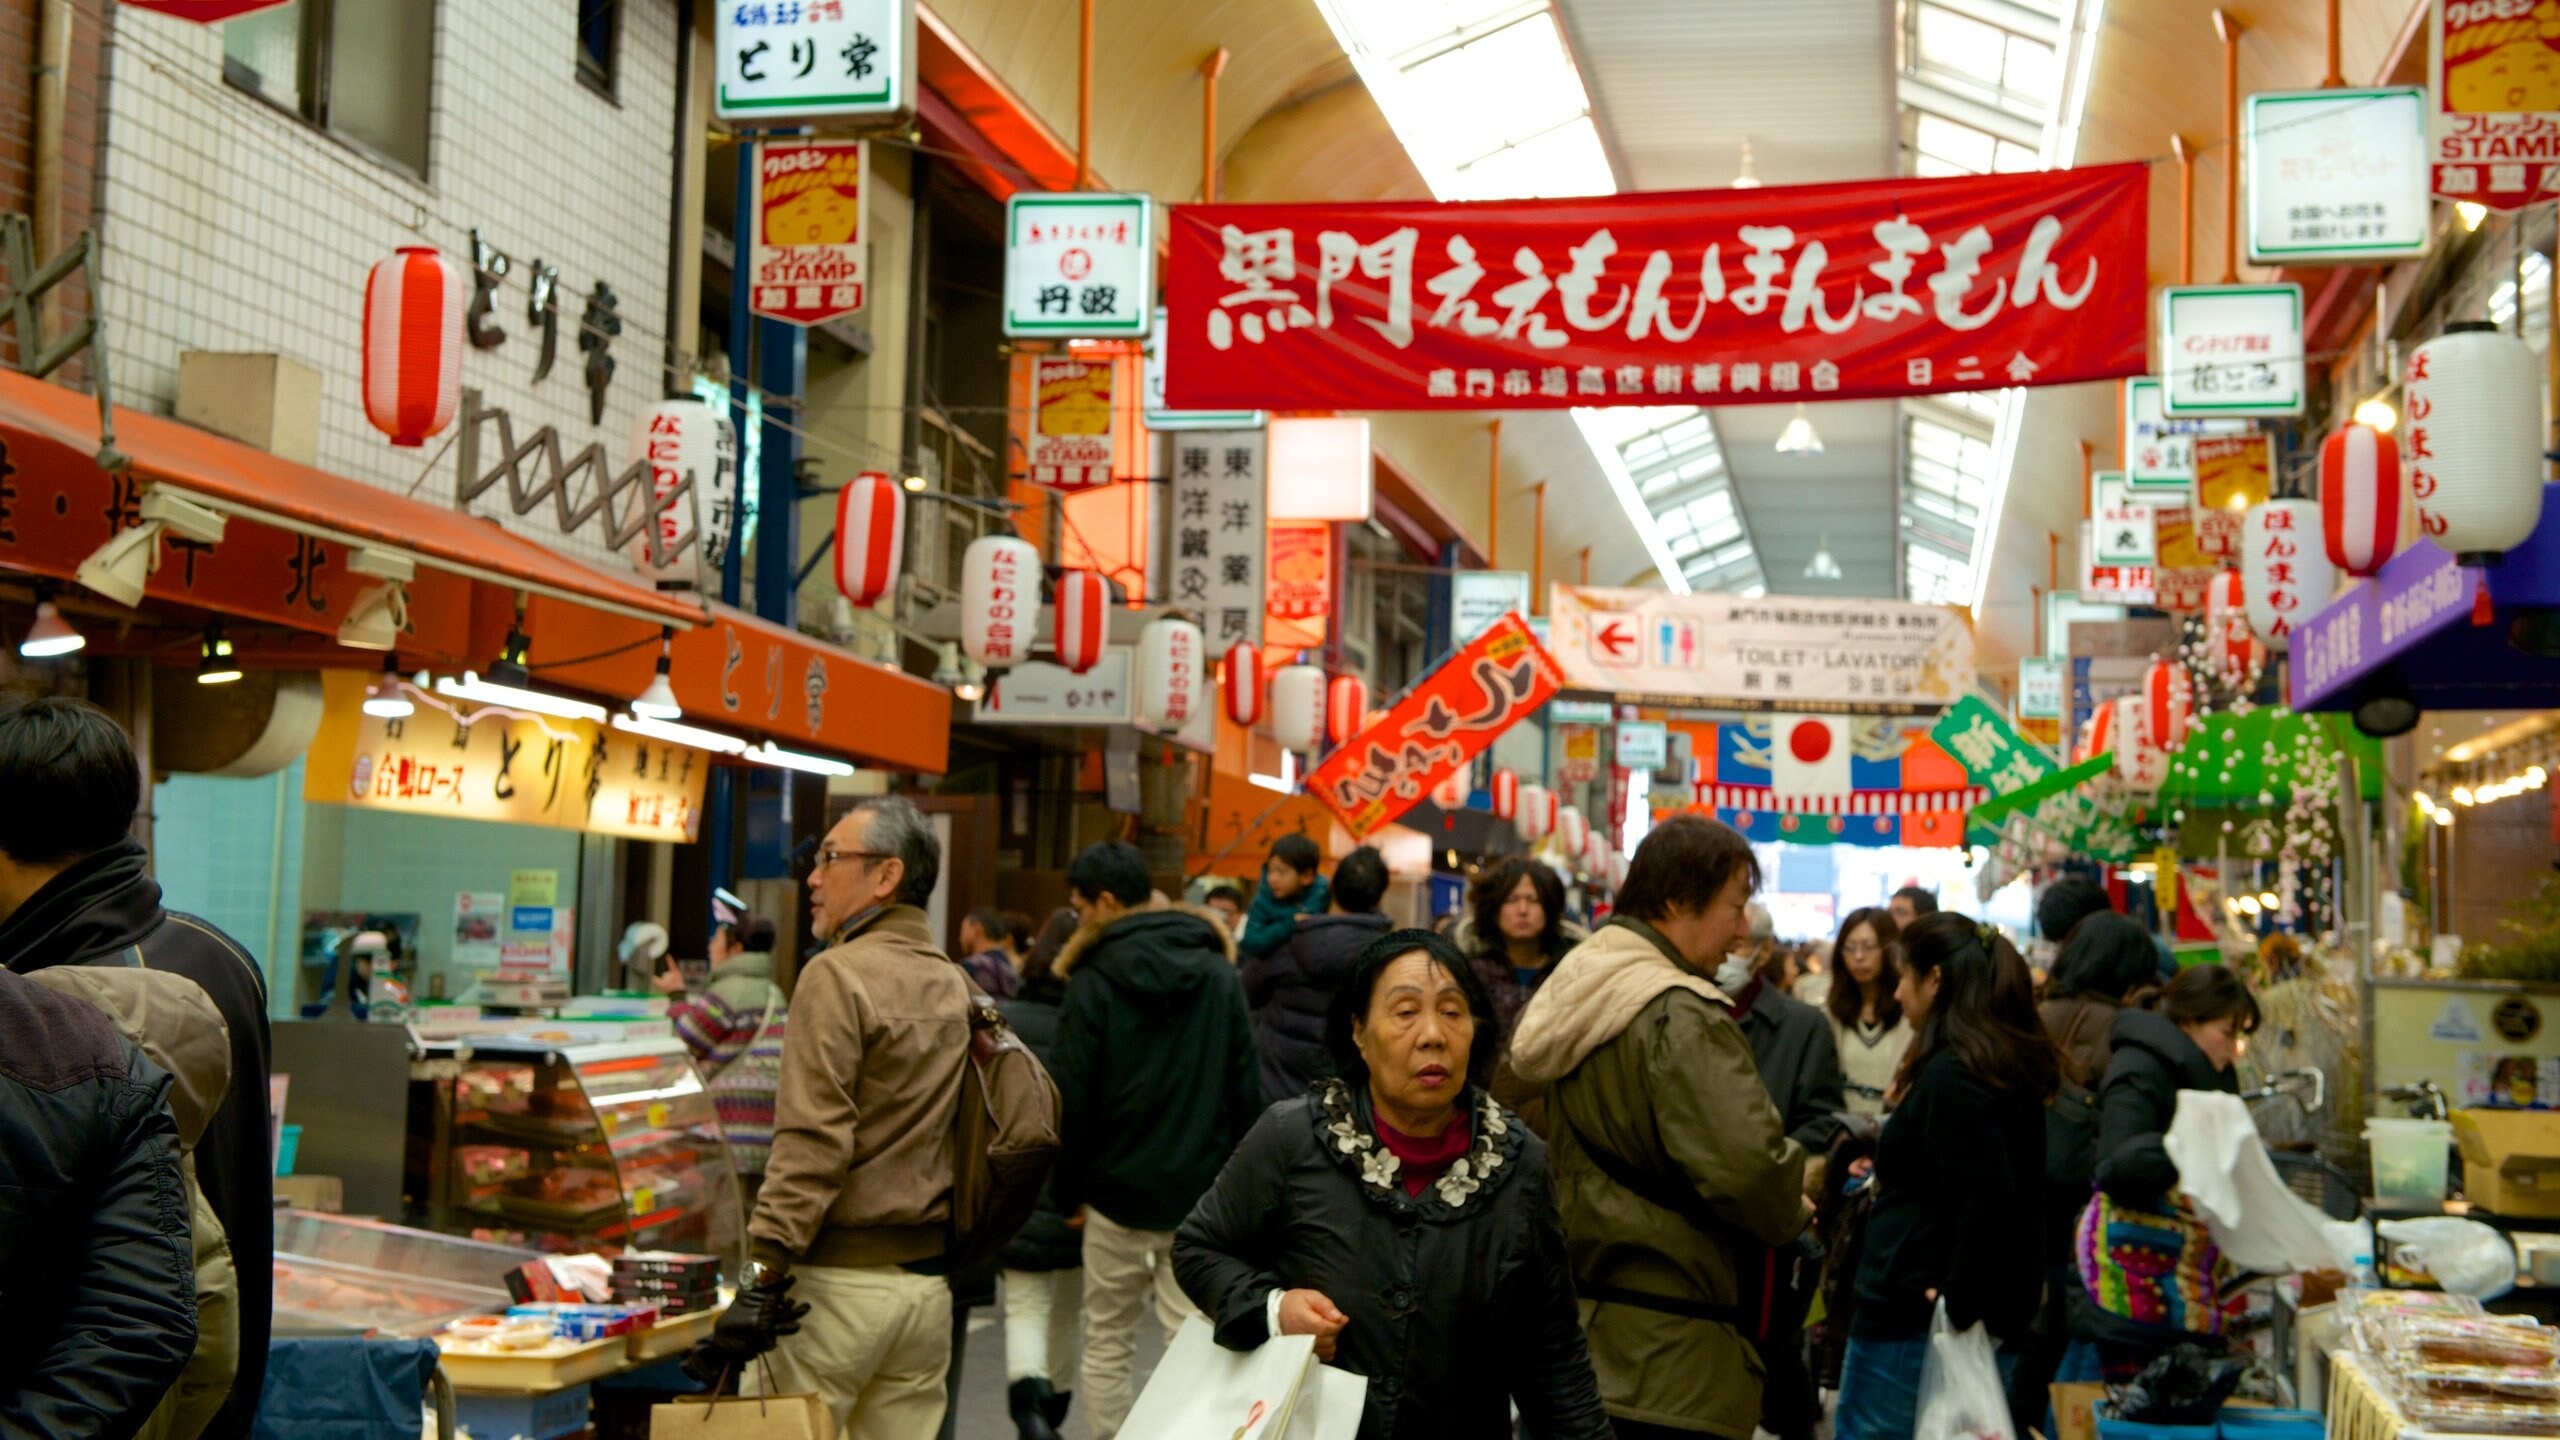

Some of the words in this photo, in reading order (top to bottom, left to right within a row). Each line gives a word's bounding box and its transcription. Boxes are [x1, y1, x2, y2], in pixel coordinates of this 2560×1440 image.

[739, 33, 878, 81] とり常
[2441, 137, 2560, 158] STAM
[760, 264, 857, 281] STAMP
[1036, 284, 1117, 315] 丹波
[1221, 448, 1253, 640] 東洋薬房
[2263, 510, 2298, 638] ほんまもん
[985, 549, 1016, 659] なにわの台所
[1736, 648, 1806, 667] TOILET
[1824, 651, 1936, 672] LAVATORY
[376, 752, 464, 805] 合鴨ロース
